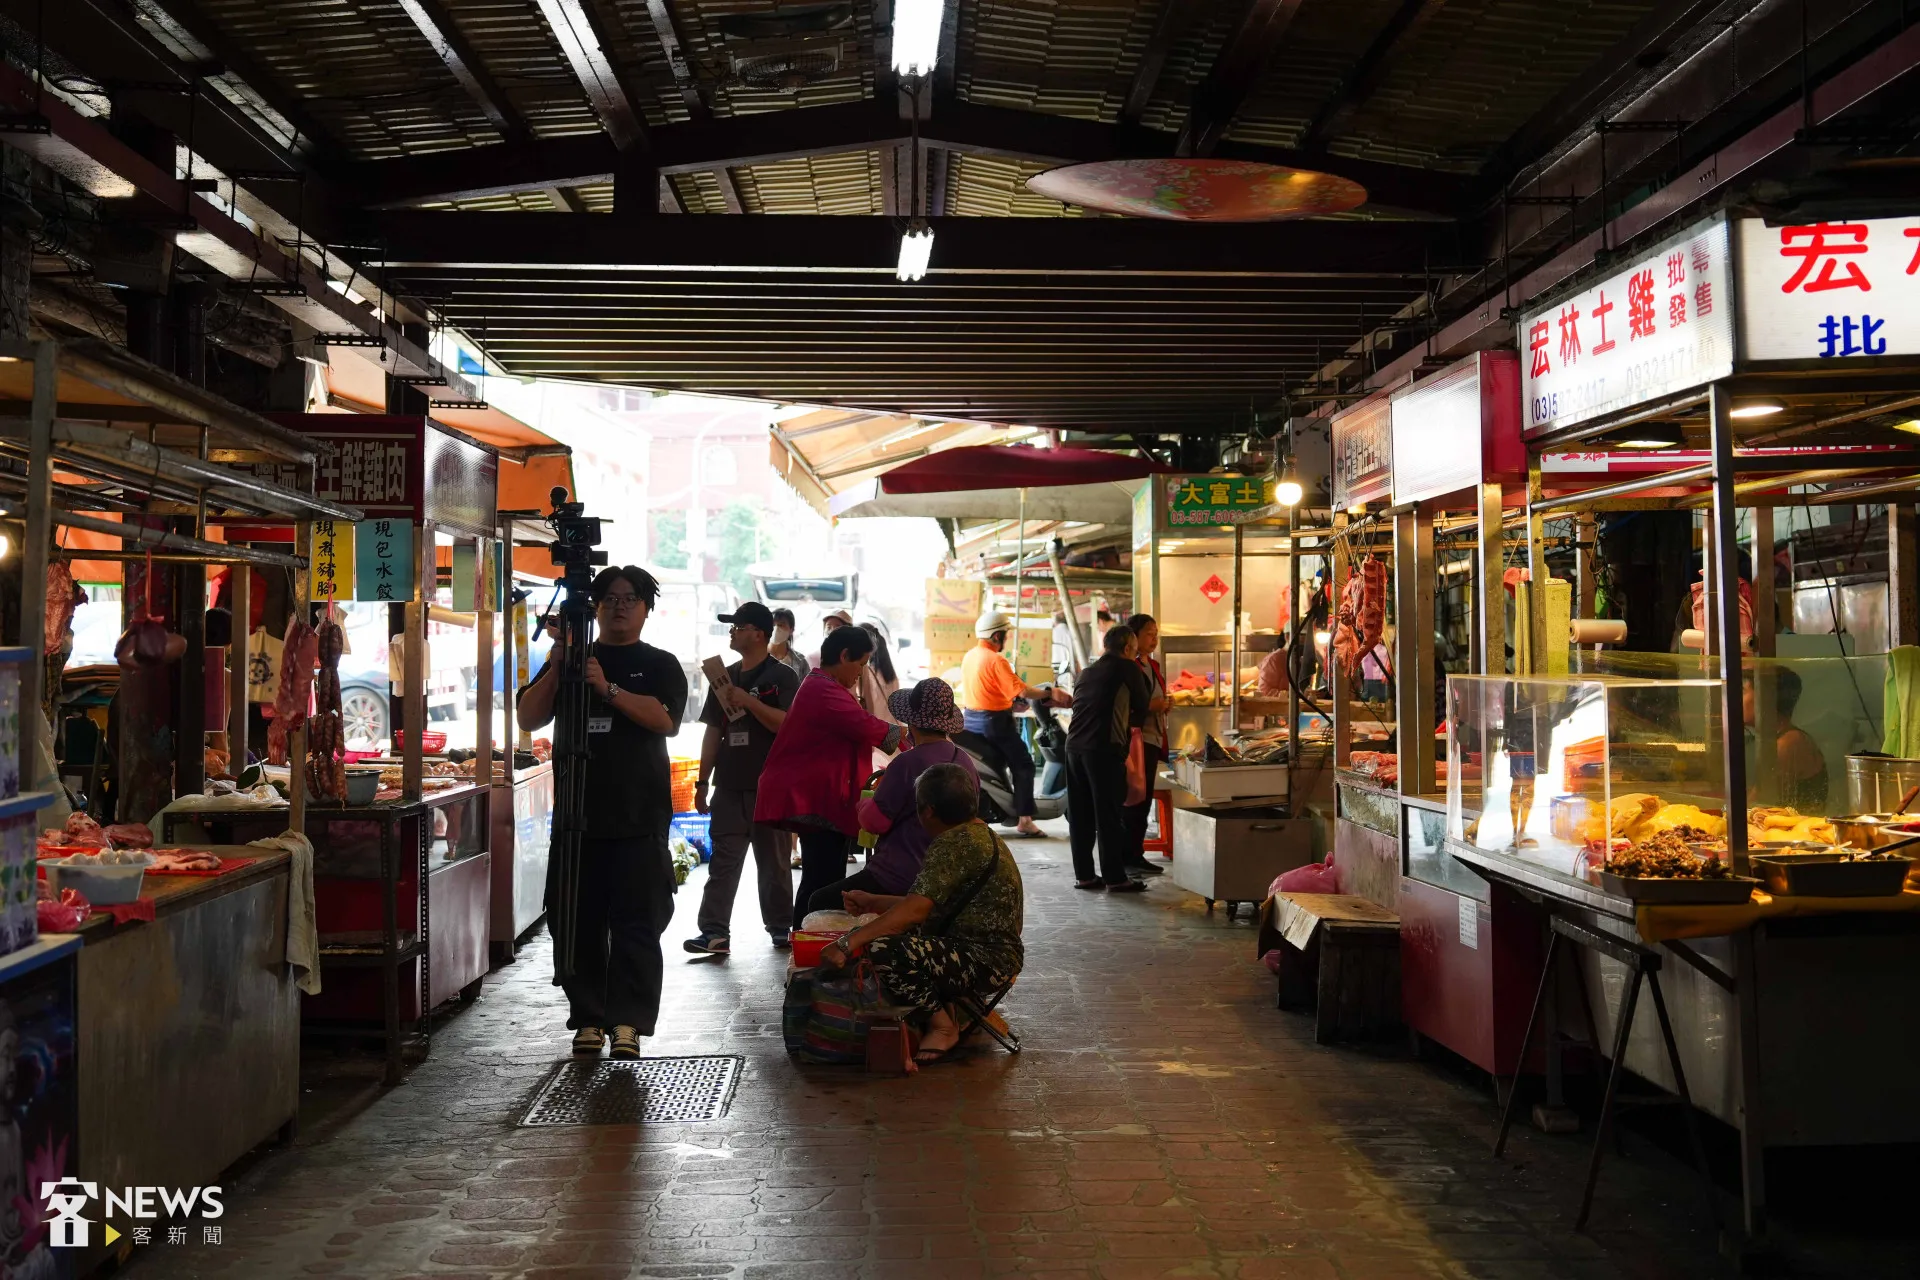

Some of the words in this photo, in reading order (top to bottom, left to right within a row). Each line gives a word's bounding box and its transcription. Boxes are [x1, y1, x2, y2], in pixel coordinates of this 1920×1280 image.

[1780, 222, 1920, 293] 宏
[1529, 268, 1656, 379] 宏林土雞
[1818, 314, 1886, 358] 批
[375, 520, 395, 600] 現包水餃
